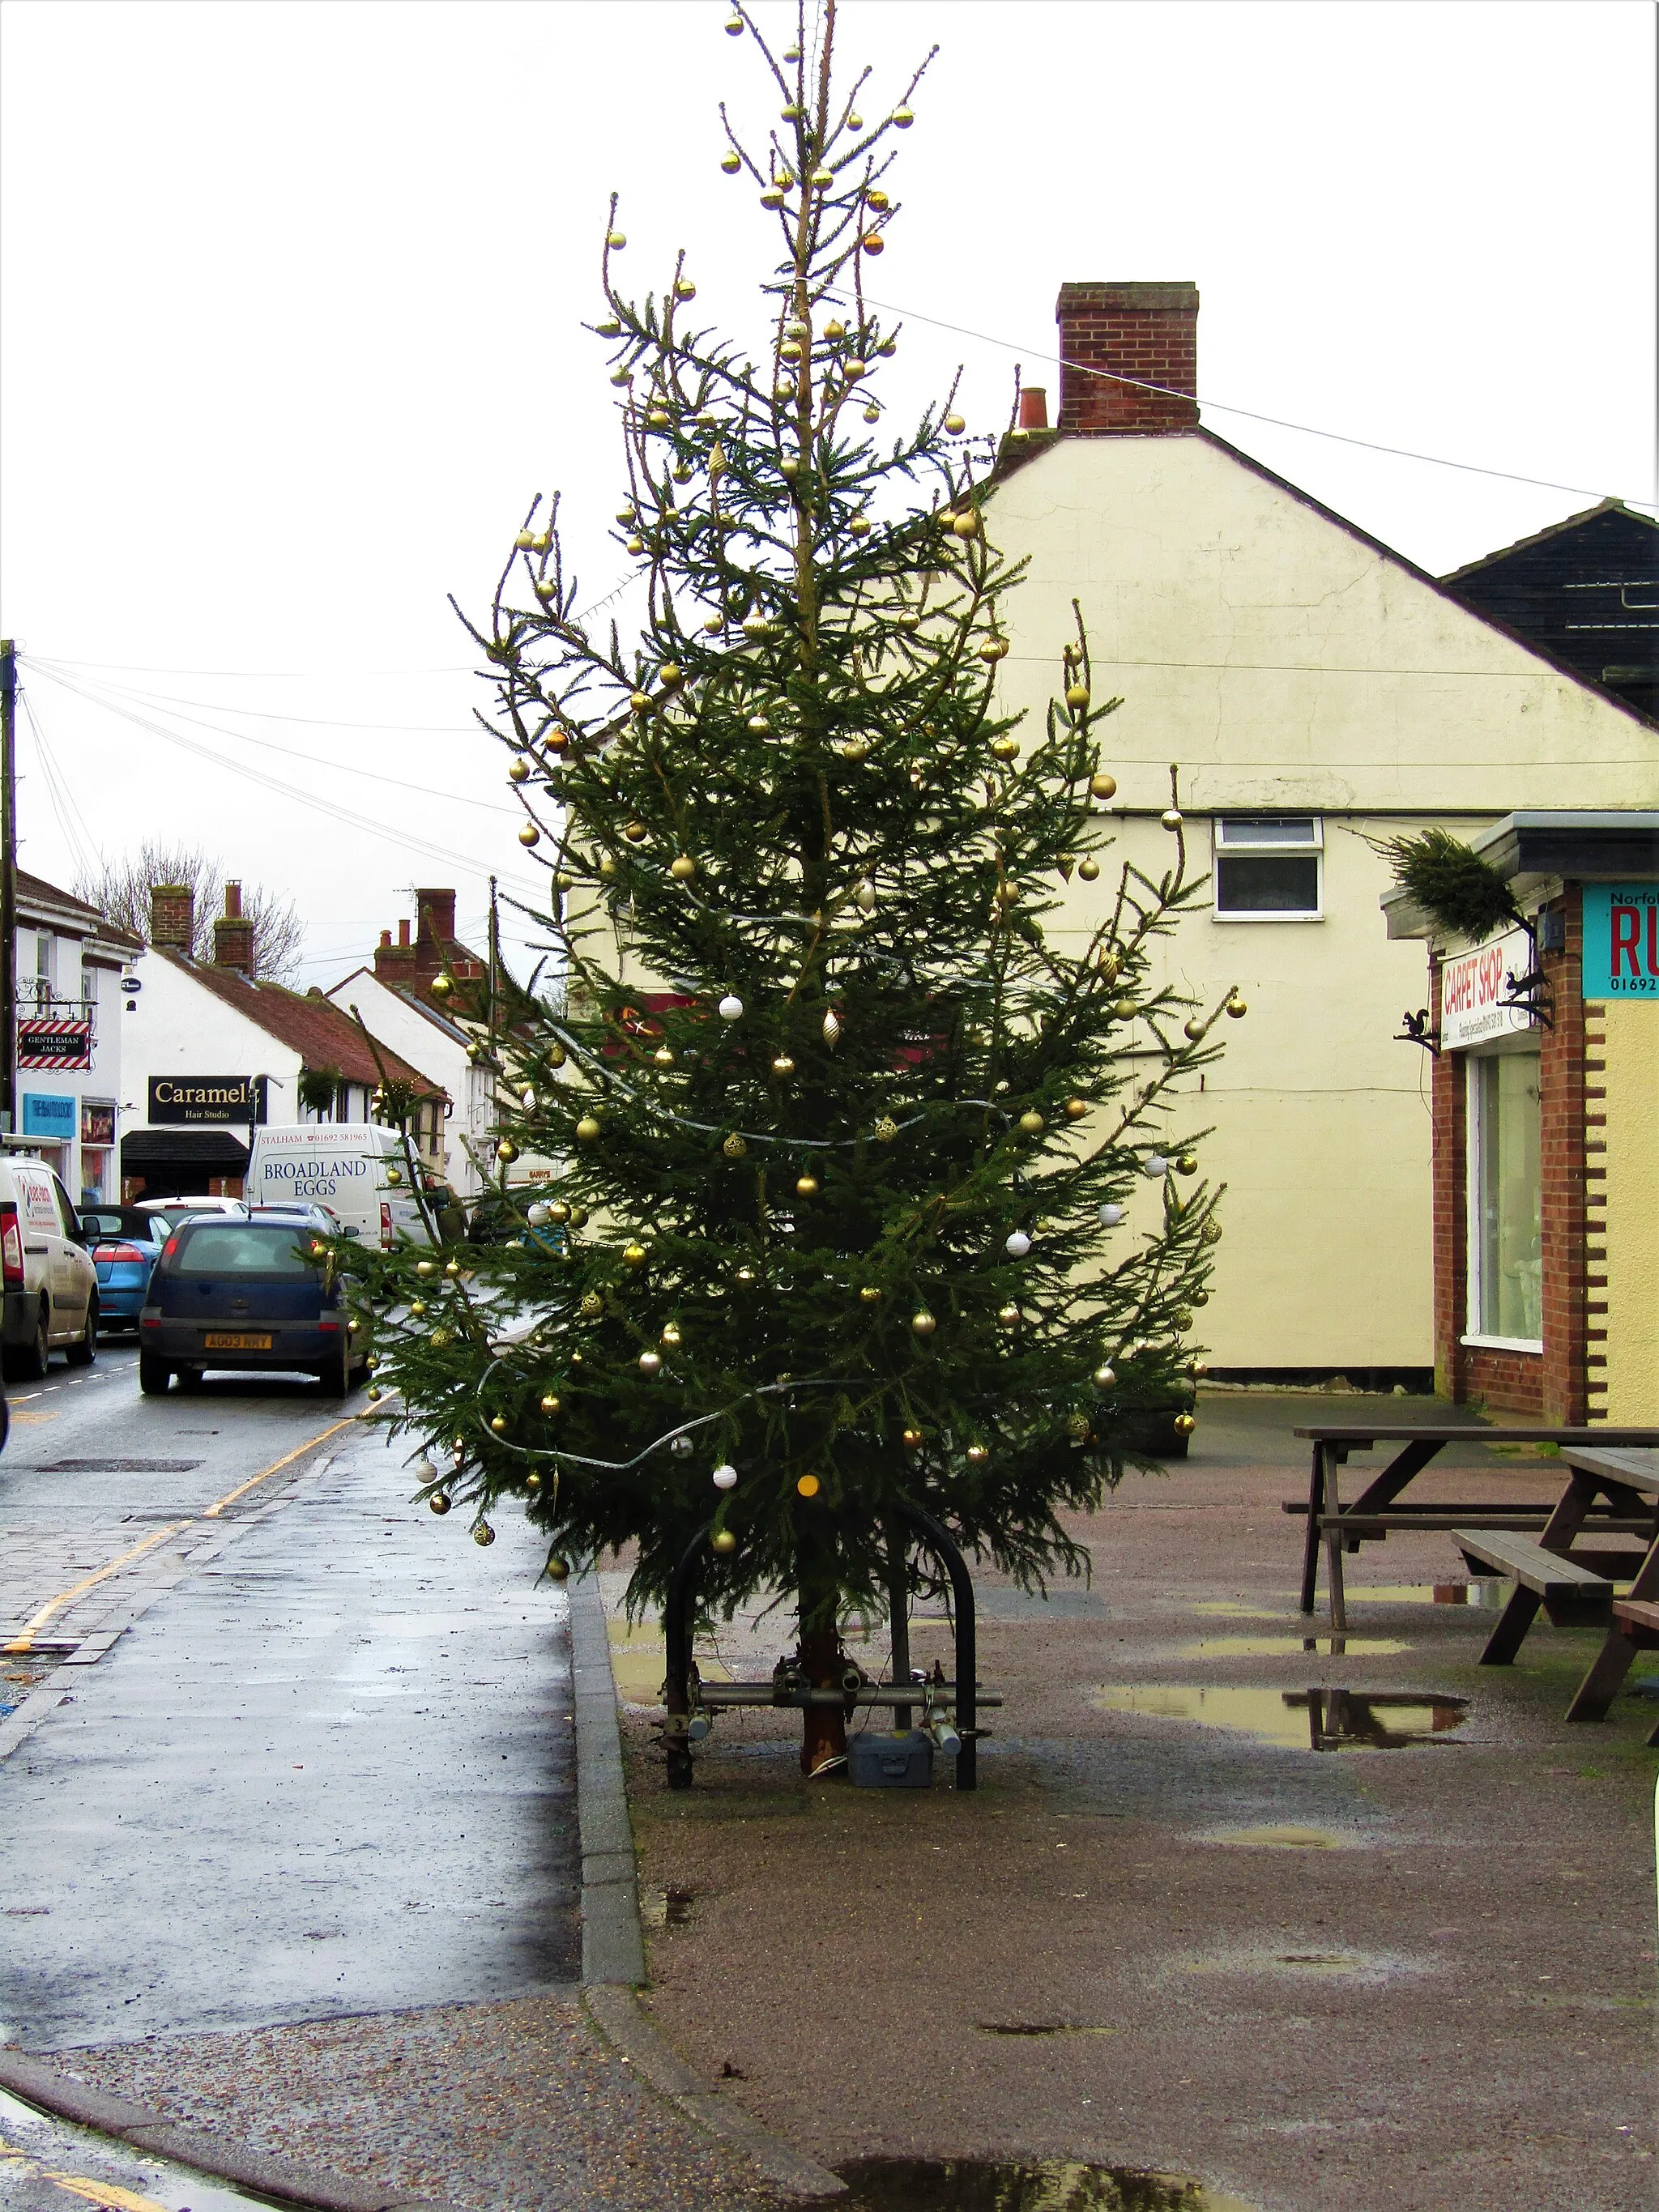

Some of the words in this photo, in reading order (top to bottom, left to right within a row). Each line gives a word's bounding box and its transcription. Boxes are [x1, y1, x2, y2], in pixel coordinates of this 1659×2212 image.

[1444, 958, 1478, 1016] CARPET
[1479, 947, 1503, 1006] SHOP
[1610, 978, 1657, 991] 01692
[28, 1037, 79, 1045] GENTLEMAN
[185, 1110, 203, 1119] Hair
[204, 1110, 229, 1119] Studio
[261, 1135, 302, 1144] STALHAM
[315, 1133, 338, 1141] 01692
[340, 1133, 367, 1141] 581965
[264, 1161, 367, 1179] BROADLAND
[294, 1179, 336, 1196] EGGS
